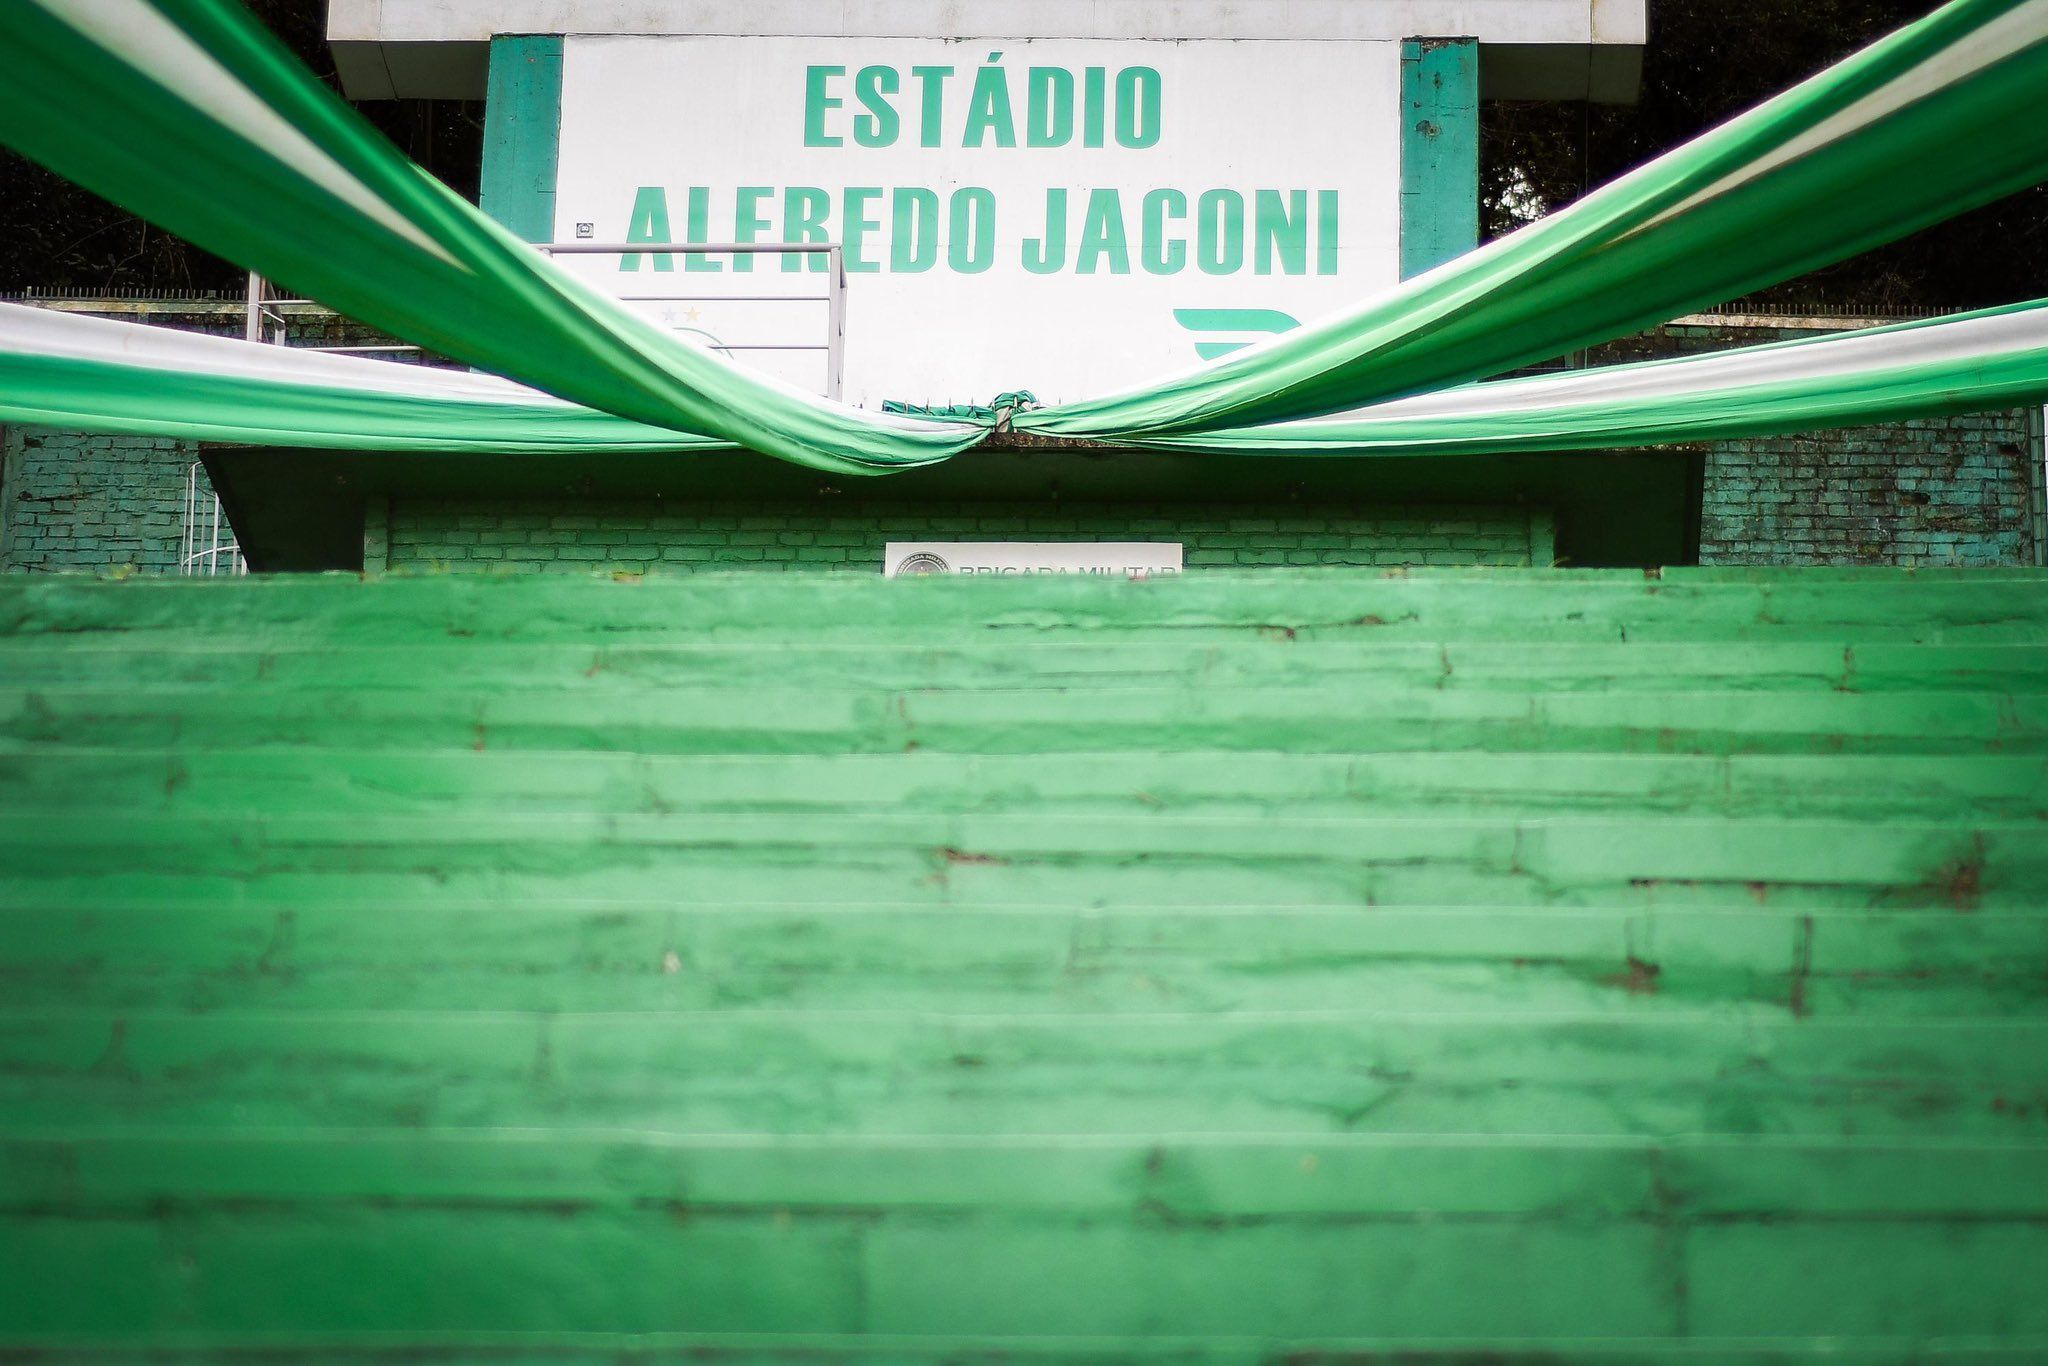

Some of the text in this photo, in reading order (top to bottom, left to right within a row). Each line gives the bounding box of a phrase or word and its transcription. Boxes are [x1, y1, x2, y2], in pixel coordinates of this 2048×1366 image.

[805, 51, 1162, 149] ESTÁDIO
[619, 187, 1339, 275] ALFREDO JACONI
